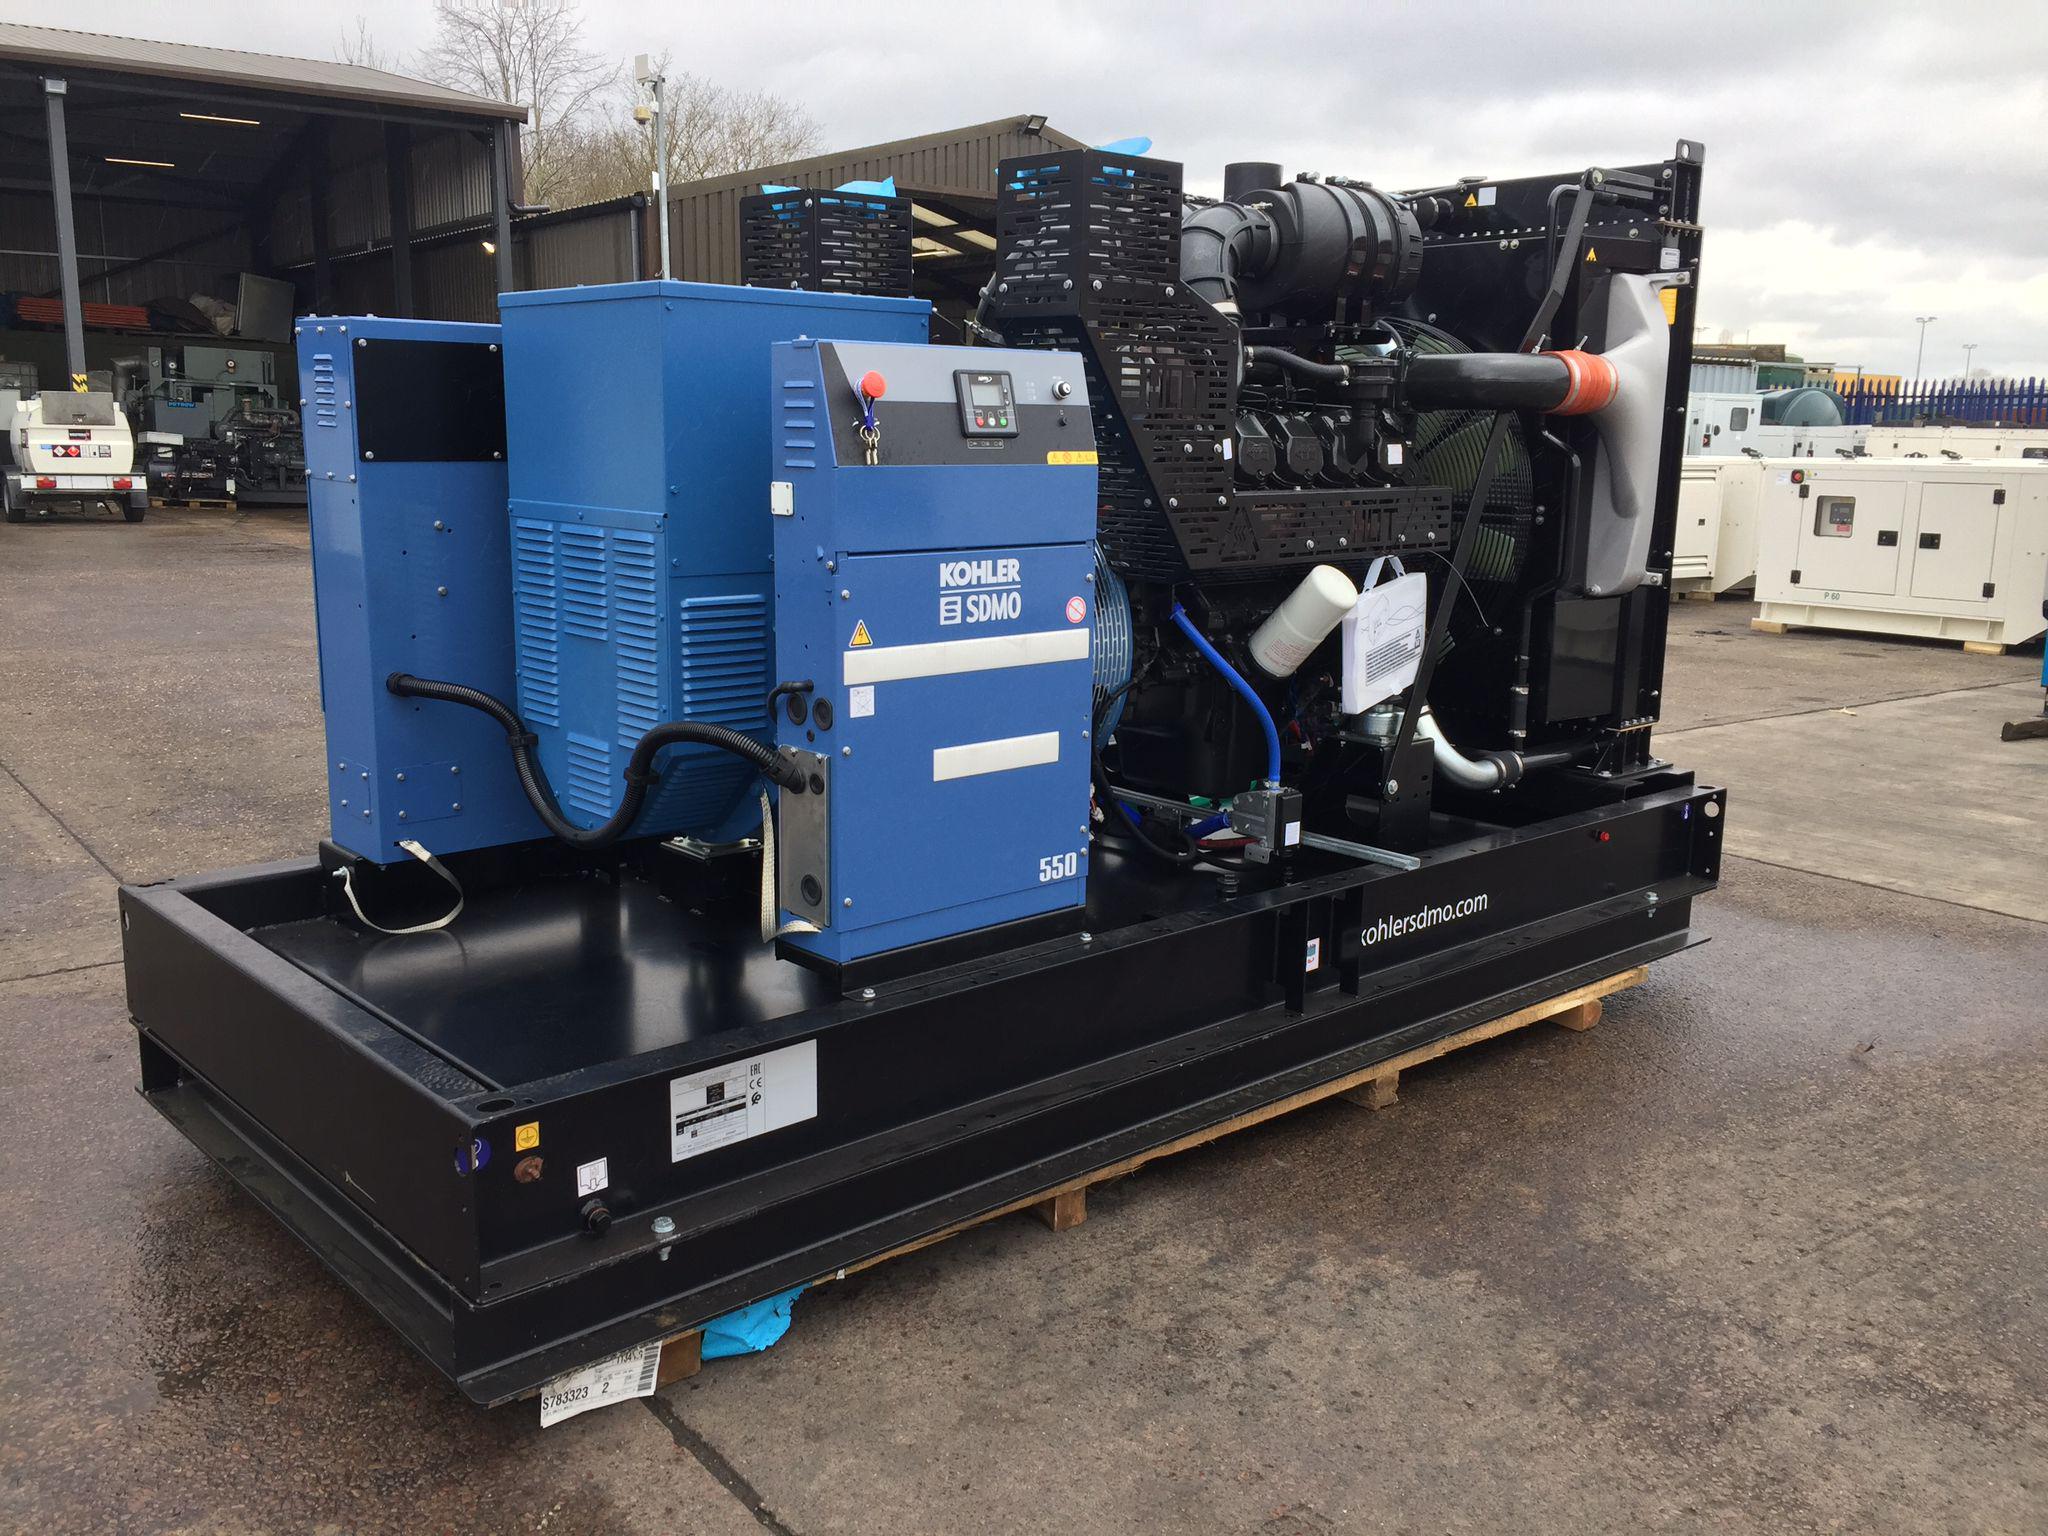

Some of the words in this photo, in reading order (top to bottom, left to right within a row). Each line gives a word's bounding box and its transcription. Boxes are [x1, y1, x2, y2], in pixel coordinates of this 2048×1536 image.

[940, 558, 1021, 587] KOHLER
[966, 591, 1022, 624] SDMO
[1039, 851, 1077, 882] 550
[542, 1386, 589, 1411] S783323
[601, 1382, 610, 1394] 2
